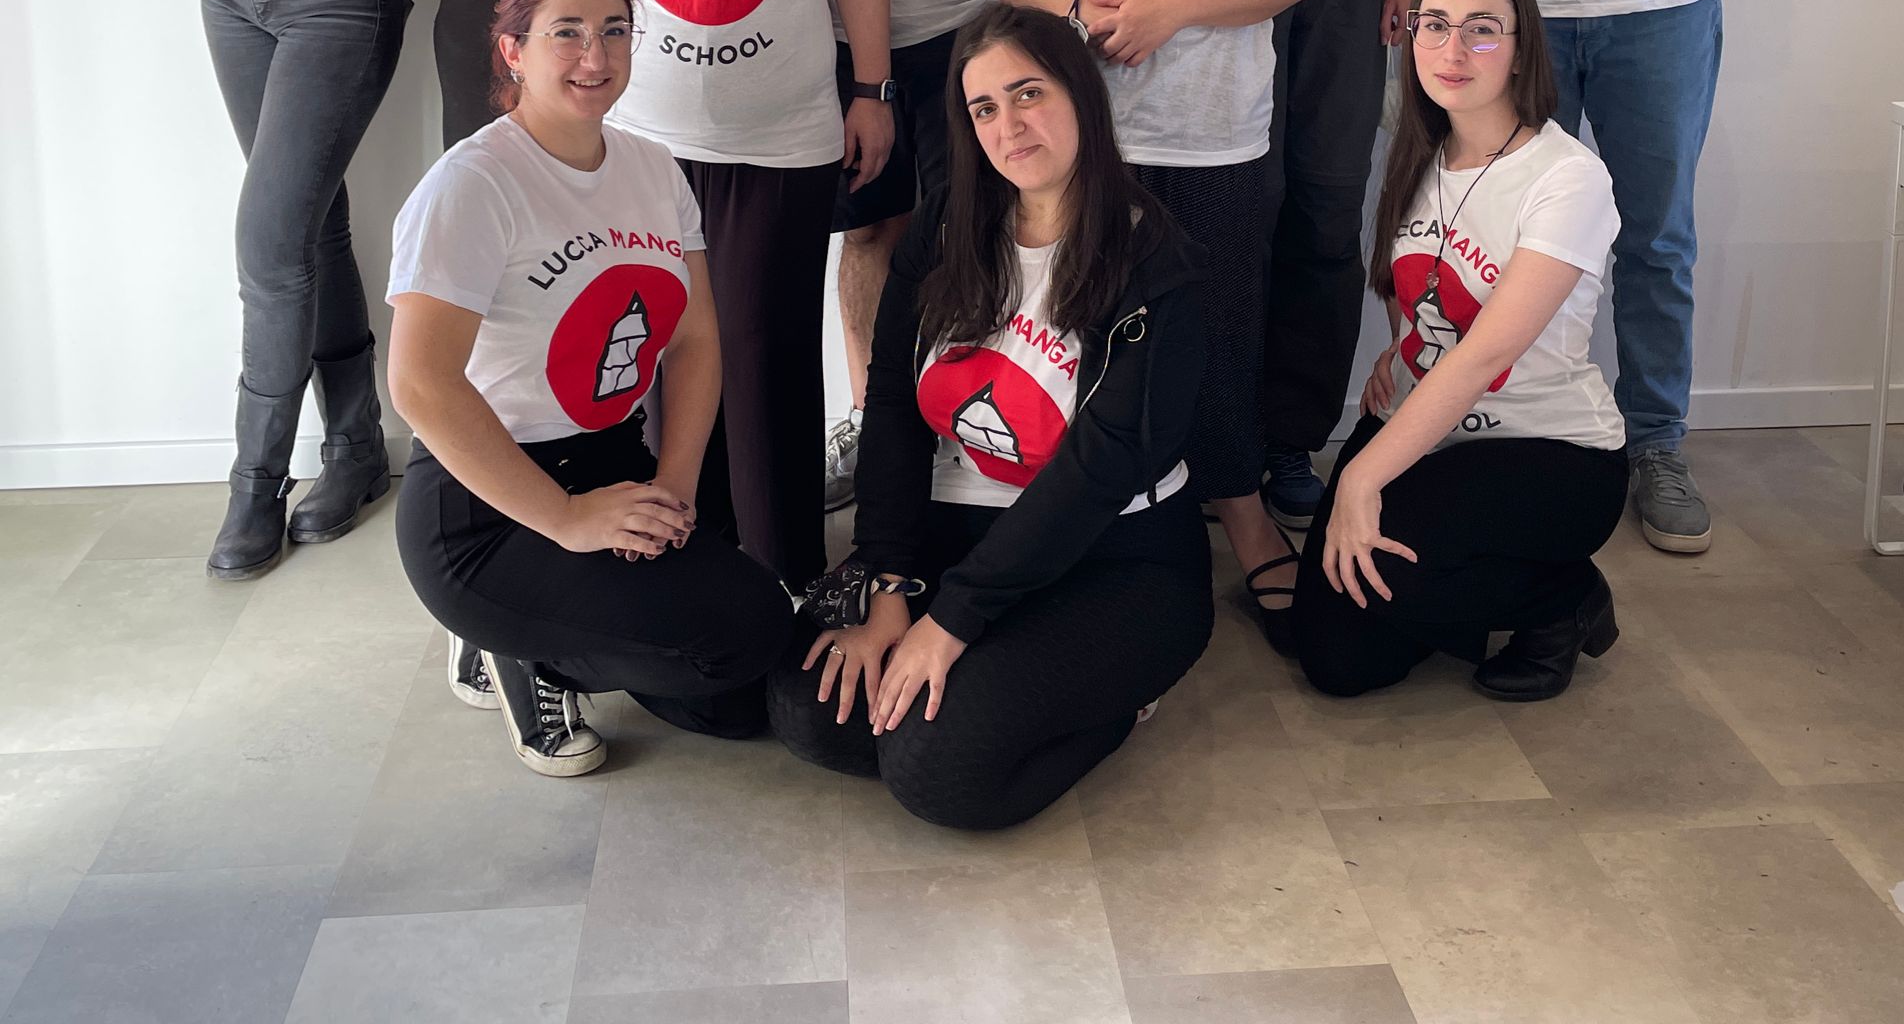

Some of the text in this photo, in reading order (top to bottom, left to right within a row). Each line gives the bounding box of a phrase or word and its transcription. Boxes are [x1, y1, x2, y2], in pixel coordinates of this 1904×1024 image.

[659, 31, 774, 66] SCHOOL
[527, 227, 685, 291] LUCCA MANG
[1442, 223, 1501, 289] MANG
[1006, 310, 1079, 381] MANGA
